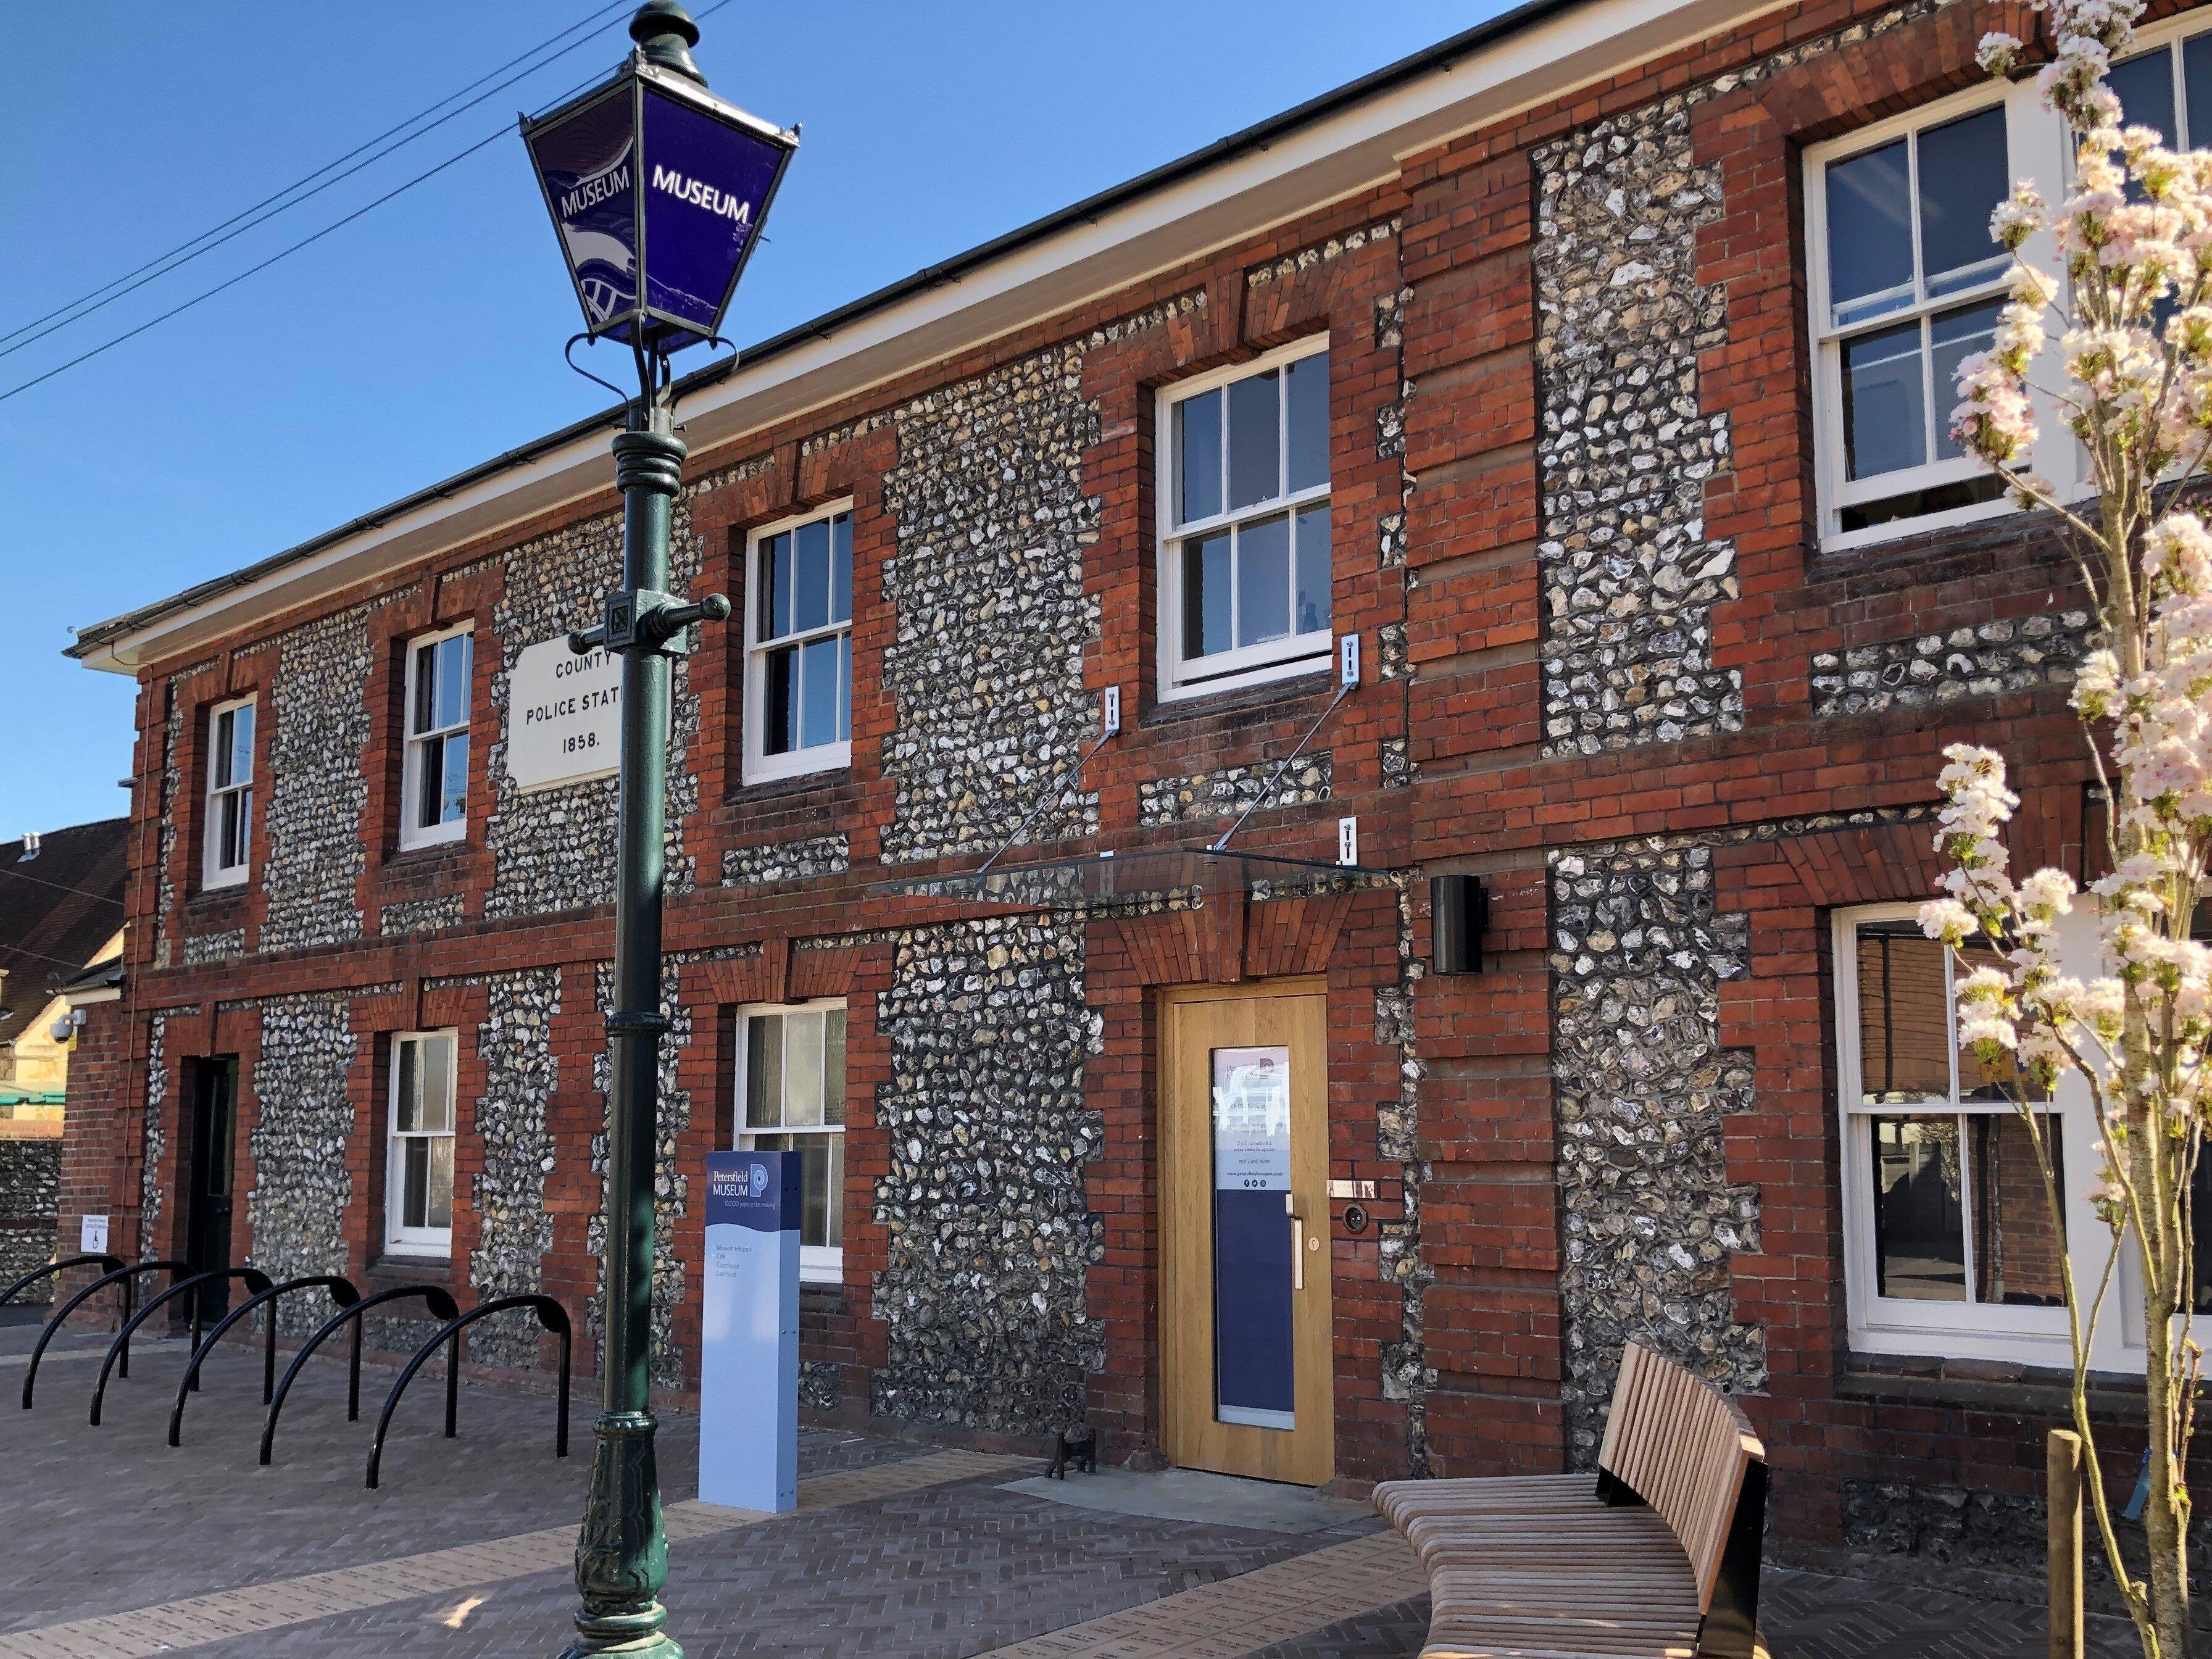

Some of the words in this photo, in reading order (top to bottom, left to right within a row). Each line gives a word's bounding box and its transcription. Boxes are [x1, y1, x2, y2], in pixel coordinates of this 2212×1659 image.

[561, 165, 630, 218] MUSEUM
[652, 164, 750, 224] MUSEUM
[556, 650, 611, 678] COUNTY
[526, 697, 576, 725] POLICE
[563, 732, 600, 754] 1858.
[713, 1170, 748, 1183] Petersfield
[713, 1184, 748, 1197] MUSEUM
[716, 1270, 736, 1278] Courtyard
